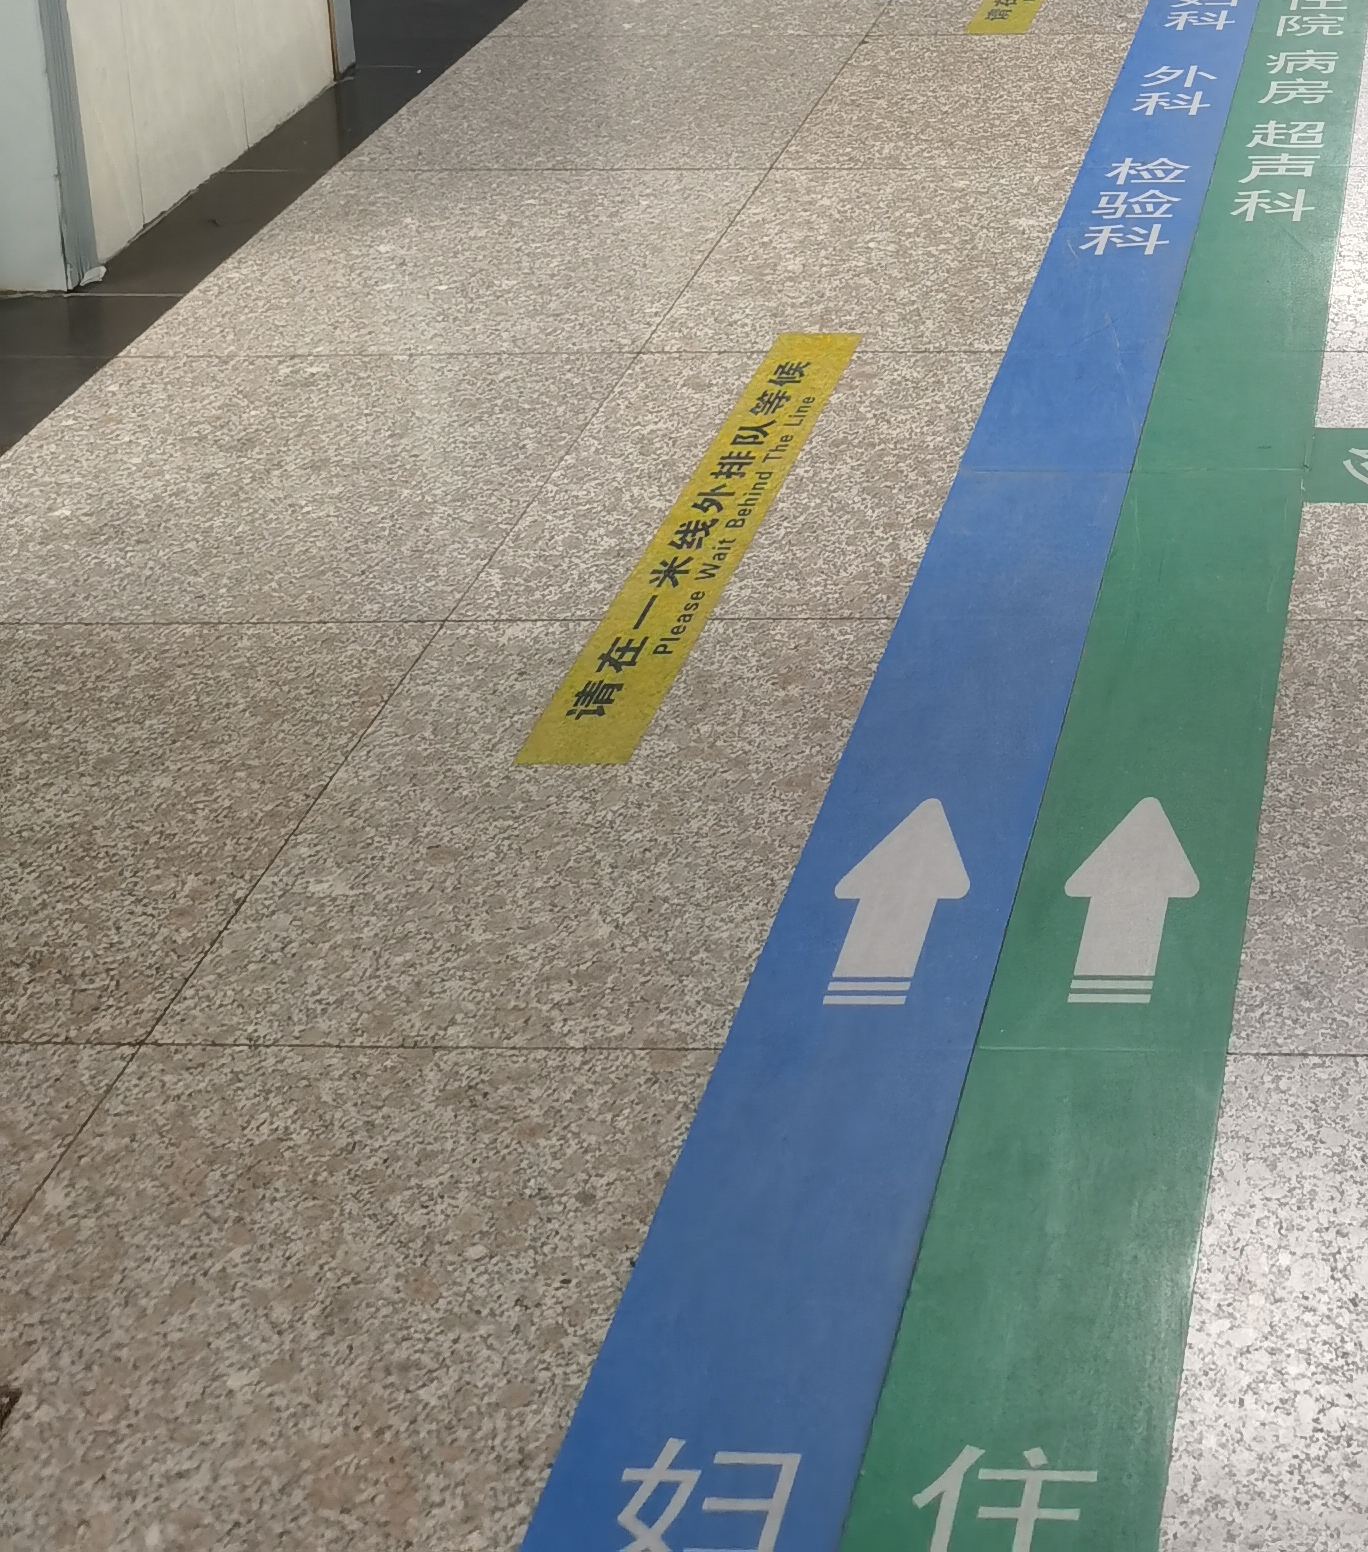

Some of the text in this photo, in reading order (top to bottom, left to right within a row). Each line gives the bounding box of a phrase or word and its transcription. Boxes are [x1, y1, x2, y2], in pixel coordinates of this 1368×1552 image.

[1132, 65, 1217, 116] 外科
[1079, 157, 1191, 256] 检验科
[566, 360, 812, 721] 请在一米线外排队等候
[653, 395, 816, 655] Please Wait Behind The Line
